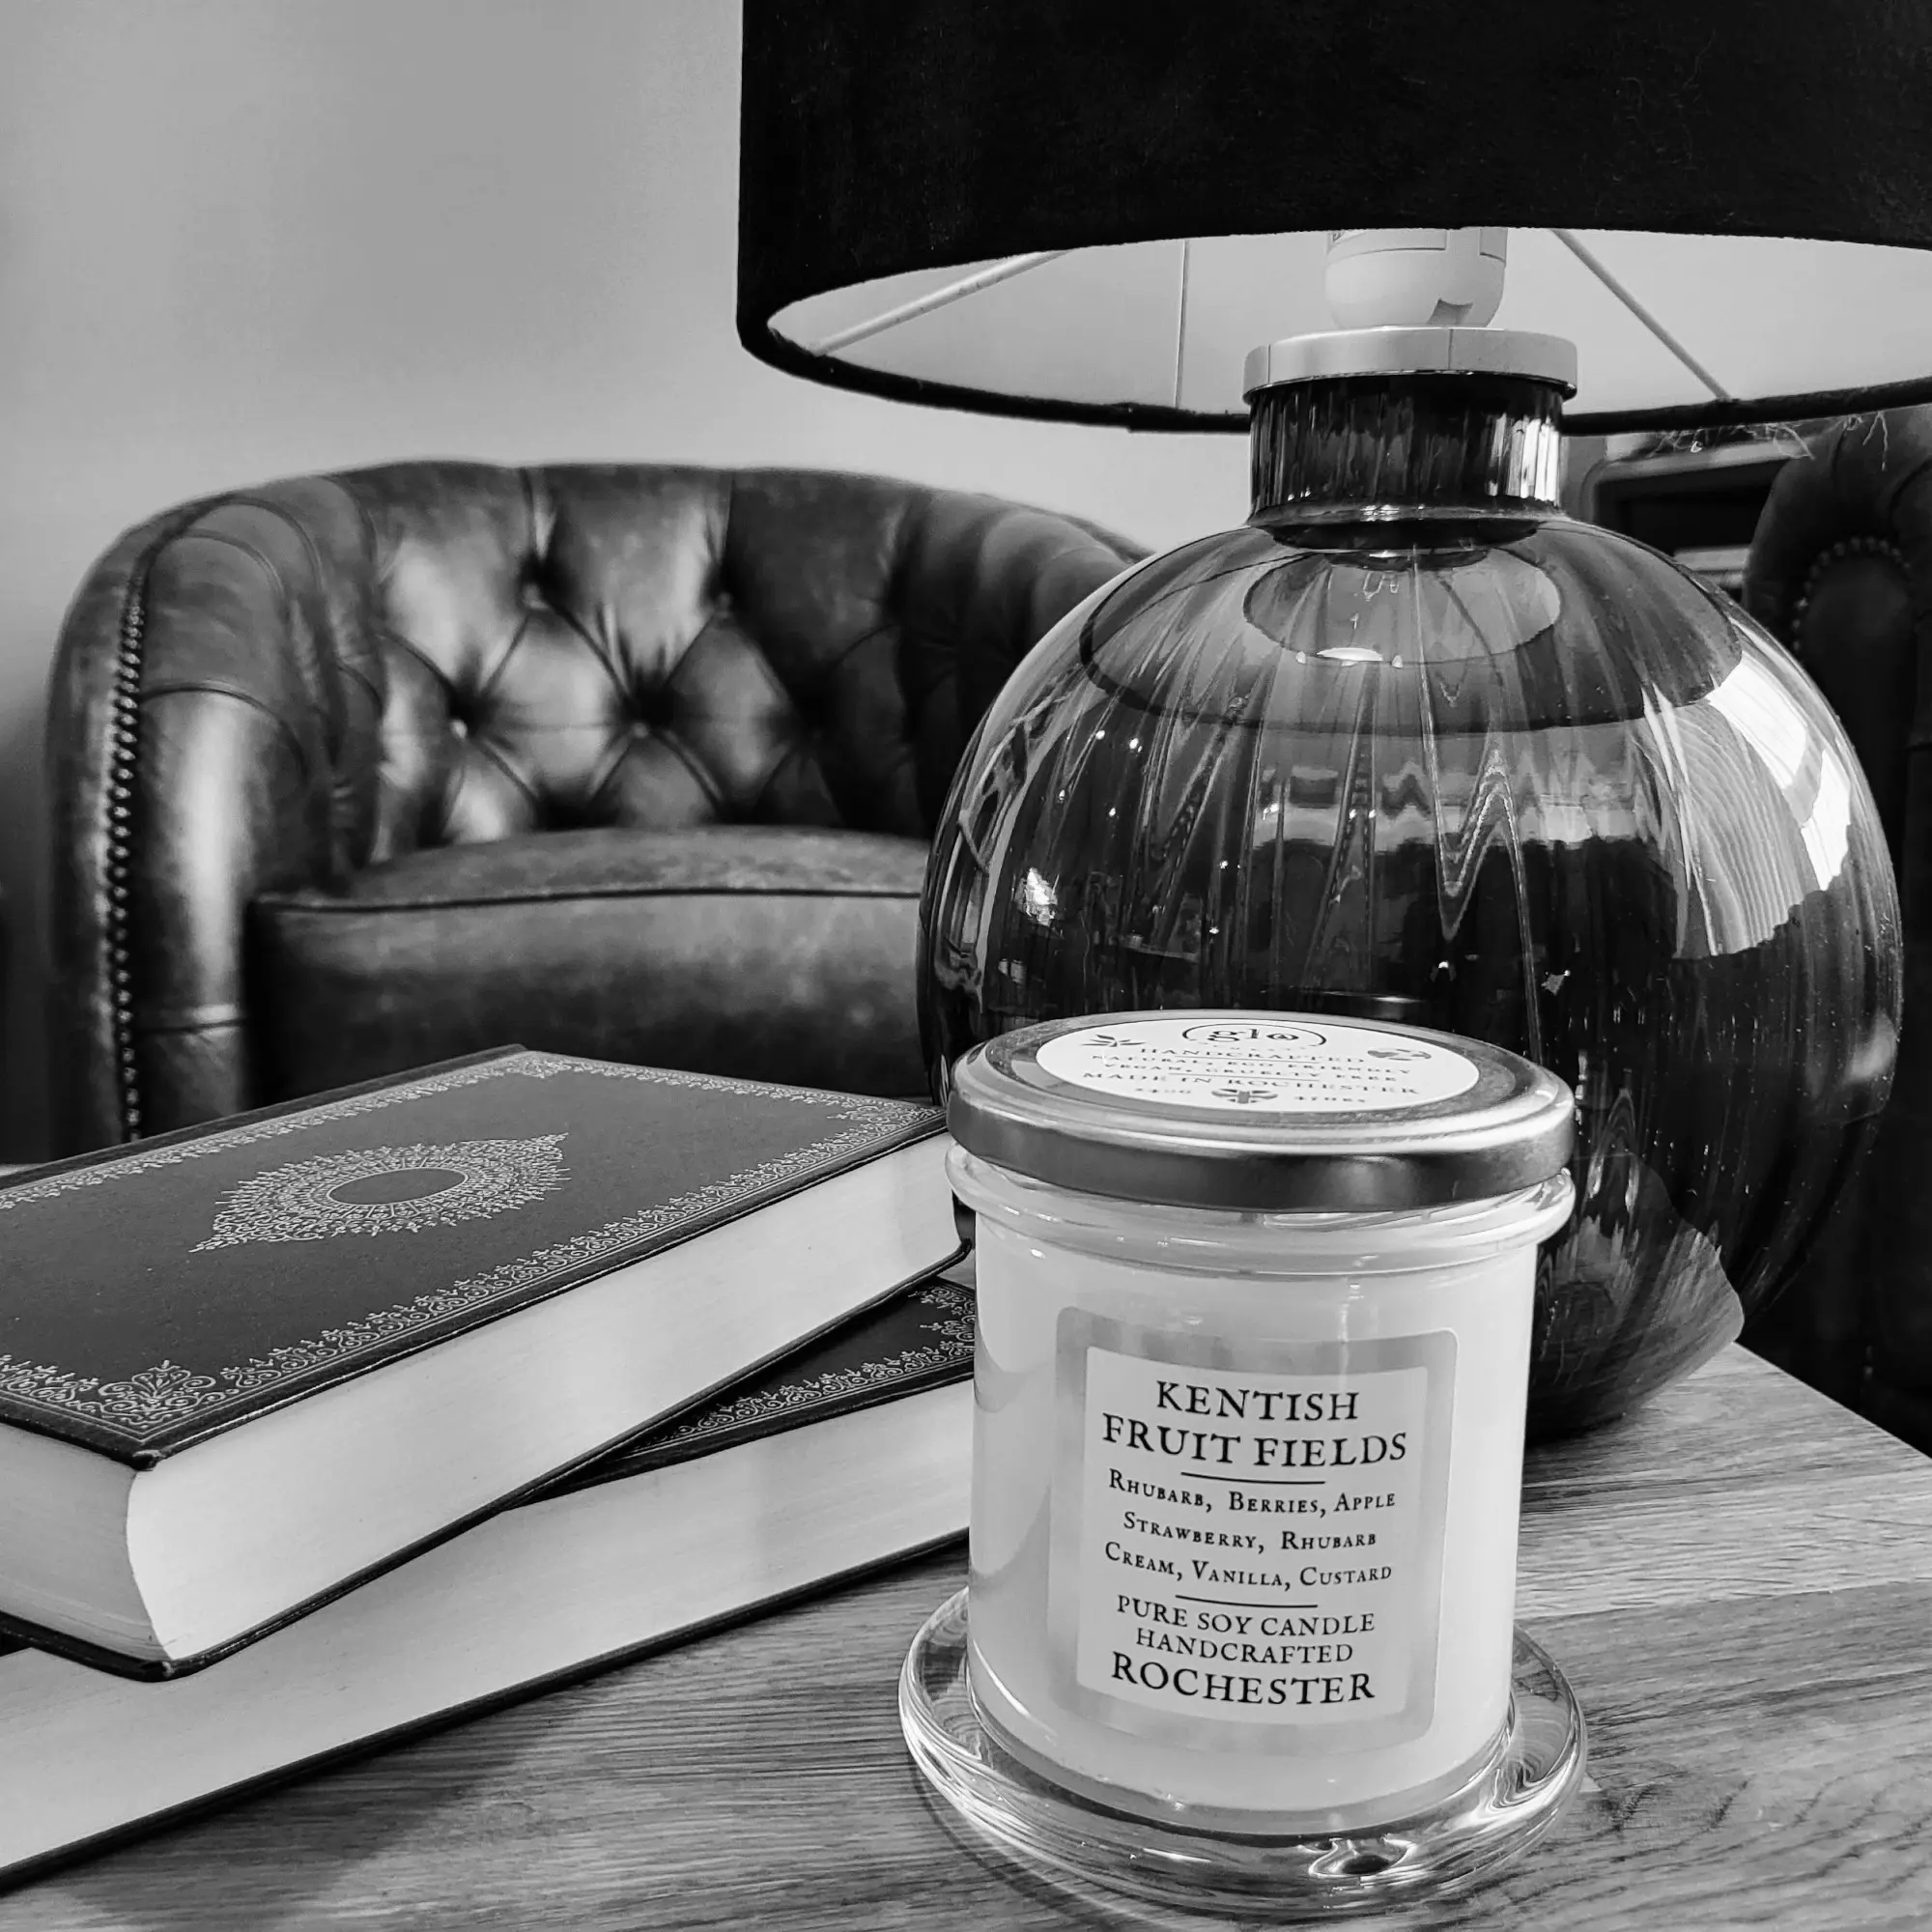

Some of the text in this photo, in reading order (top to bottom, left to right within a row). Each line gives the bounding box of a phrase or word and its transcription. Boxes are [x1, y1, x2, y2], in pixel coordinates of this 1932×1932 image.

[1141, 1048, 1364, 1063] HANDCRAFTED
[1083, 1072, 1167, 1081] MADE
[1228, 1079, 1420, 1094] ROCHESTER
[1156, 1380, 1359, 1421] KENTISH
[1102, 1413, 1406, 1467] FRUIT FIELDS
[1109, 1468, 1395, 1518] RHUBARB, BERRIES, APPLE
[1123, 1512, 1376, 1554] STRAWBERRY, RHUBARB
[1105, 1542, 1391, 1592] CREAM, VANILLA, CUSTARD
[1118, 1595, 1374, 1636] PURE SOY CANDLE
[1136, 1628, 1352, 1663] HANDCRAFTED
[1112, 1651, 1376, 1704] ROCHESTER
